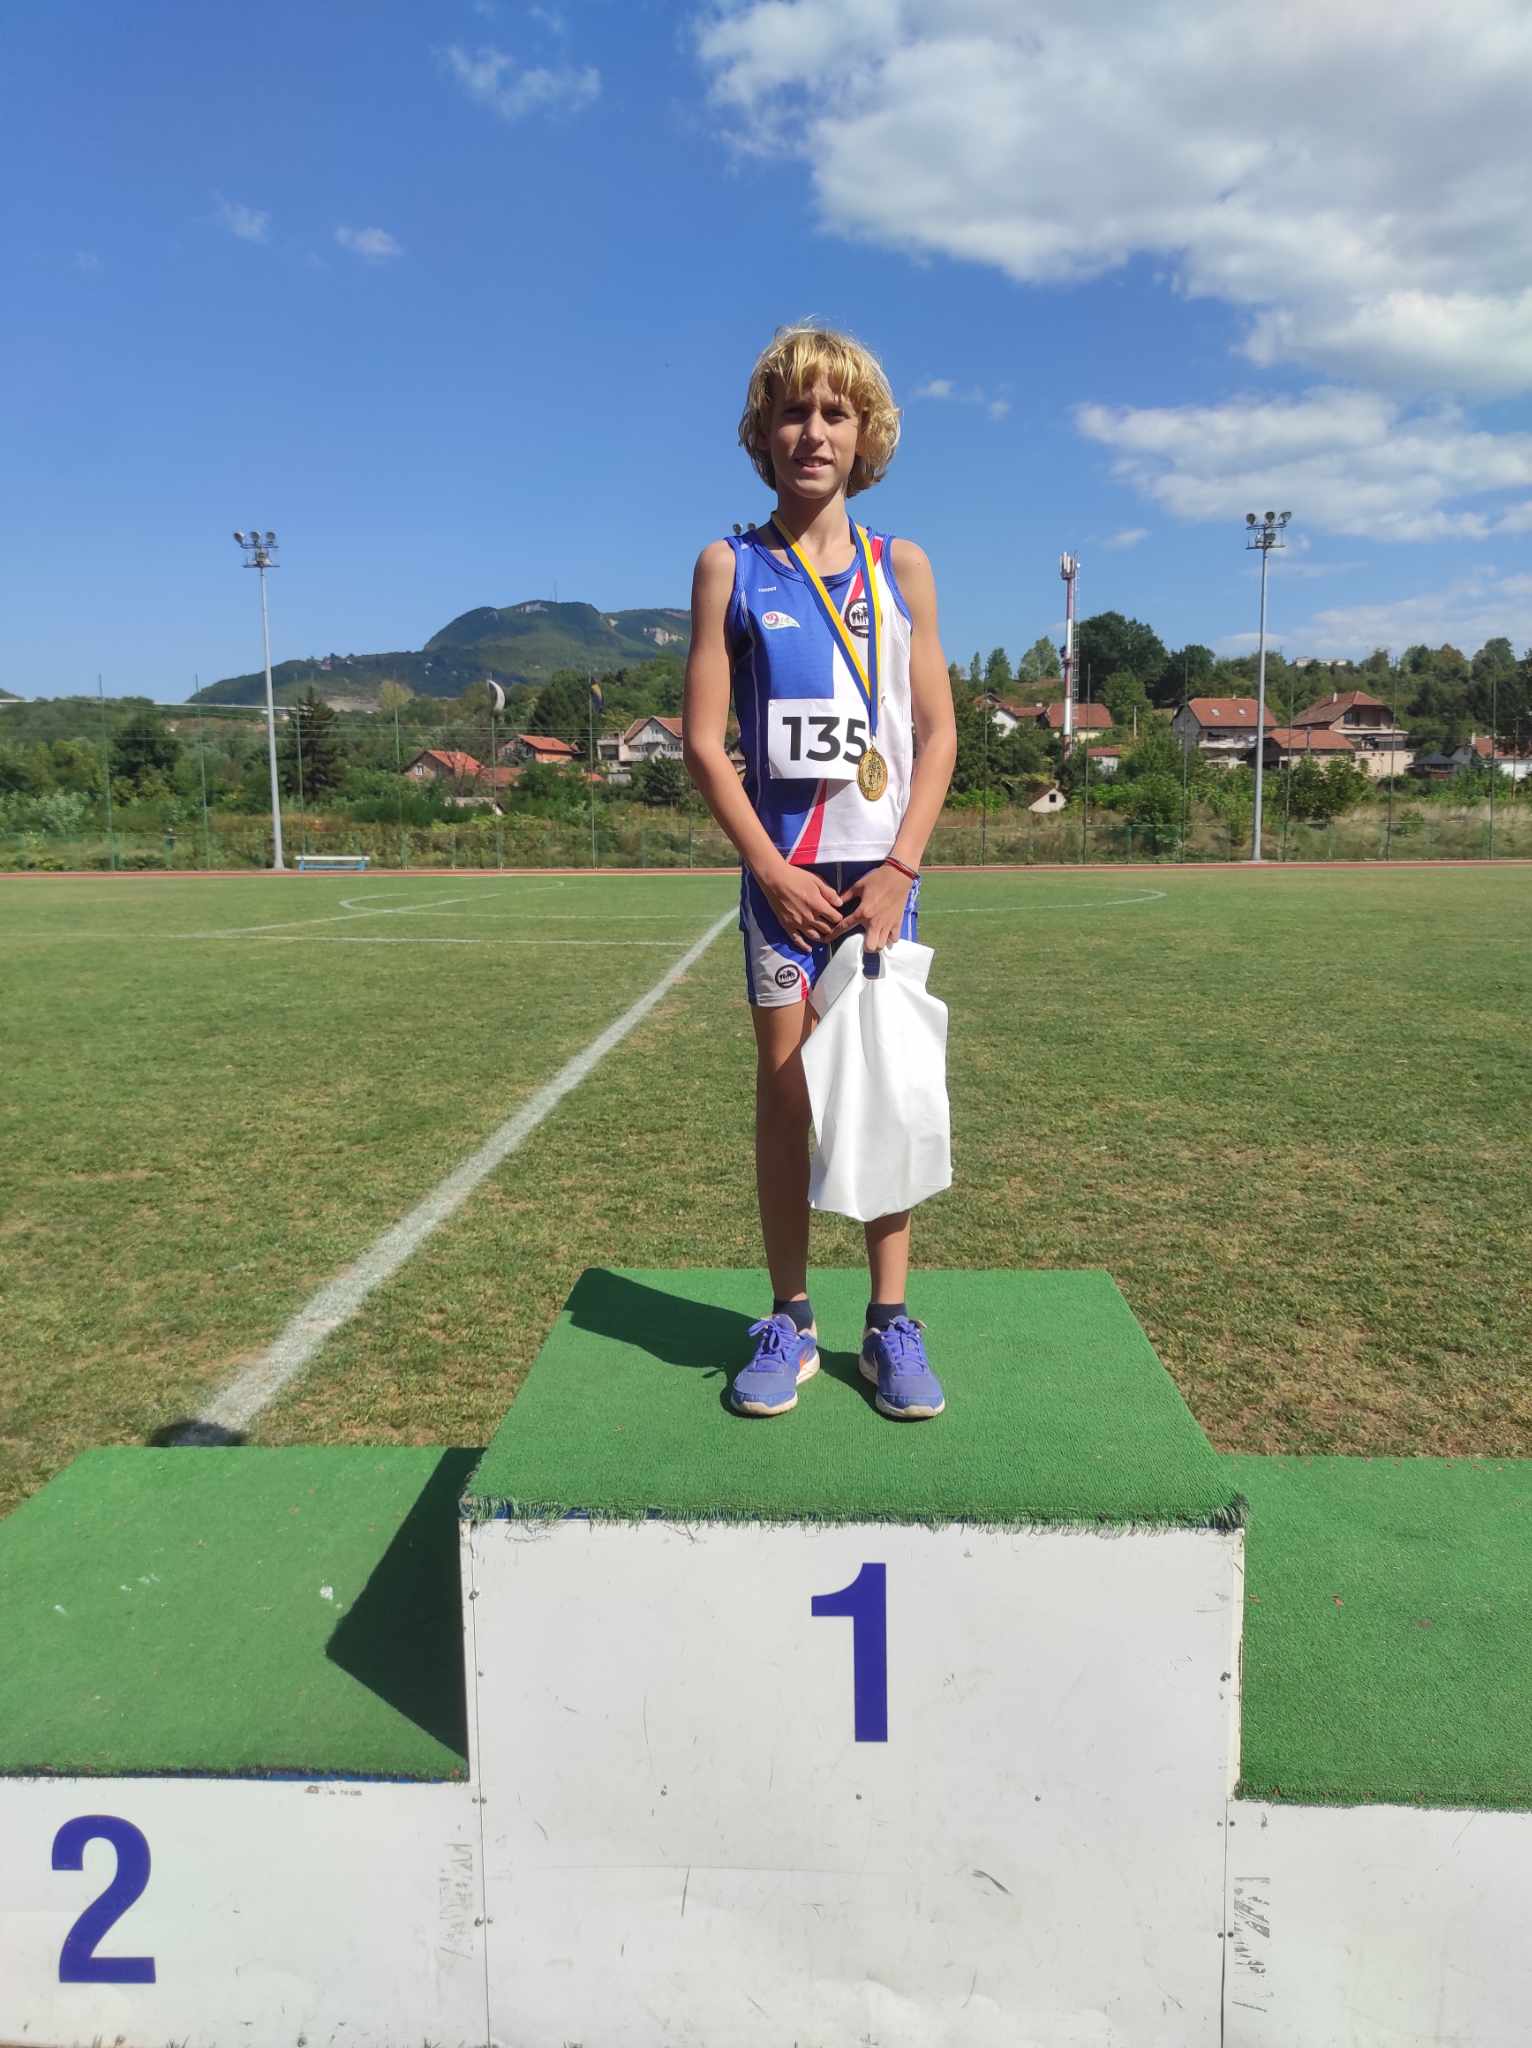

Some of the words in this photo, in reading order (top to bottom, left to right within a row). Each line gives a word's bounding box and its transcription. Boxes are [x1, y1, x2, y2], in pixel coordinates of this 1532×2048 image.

[782, 716, 867, 764] 135
[811, 1562, 888, 1743] 1
[51, 1814, 156, 1983] 2
